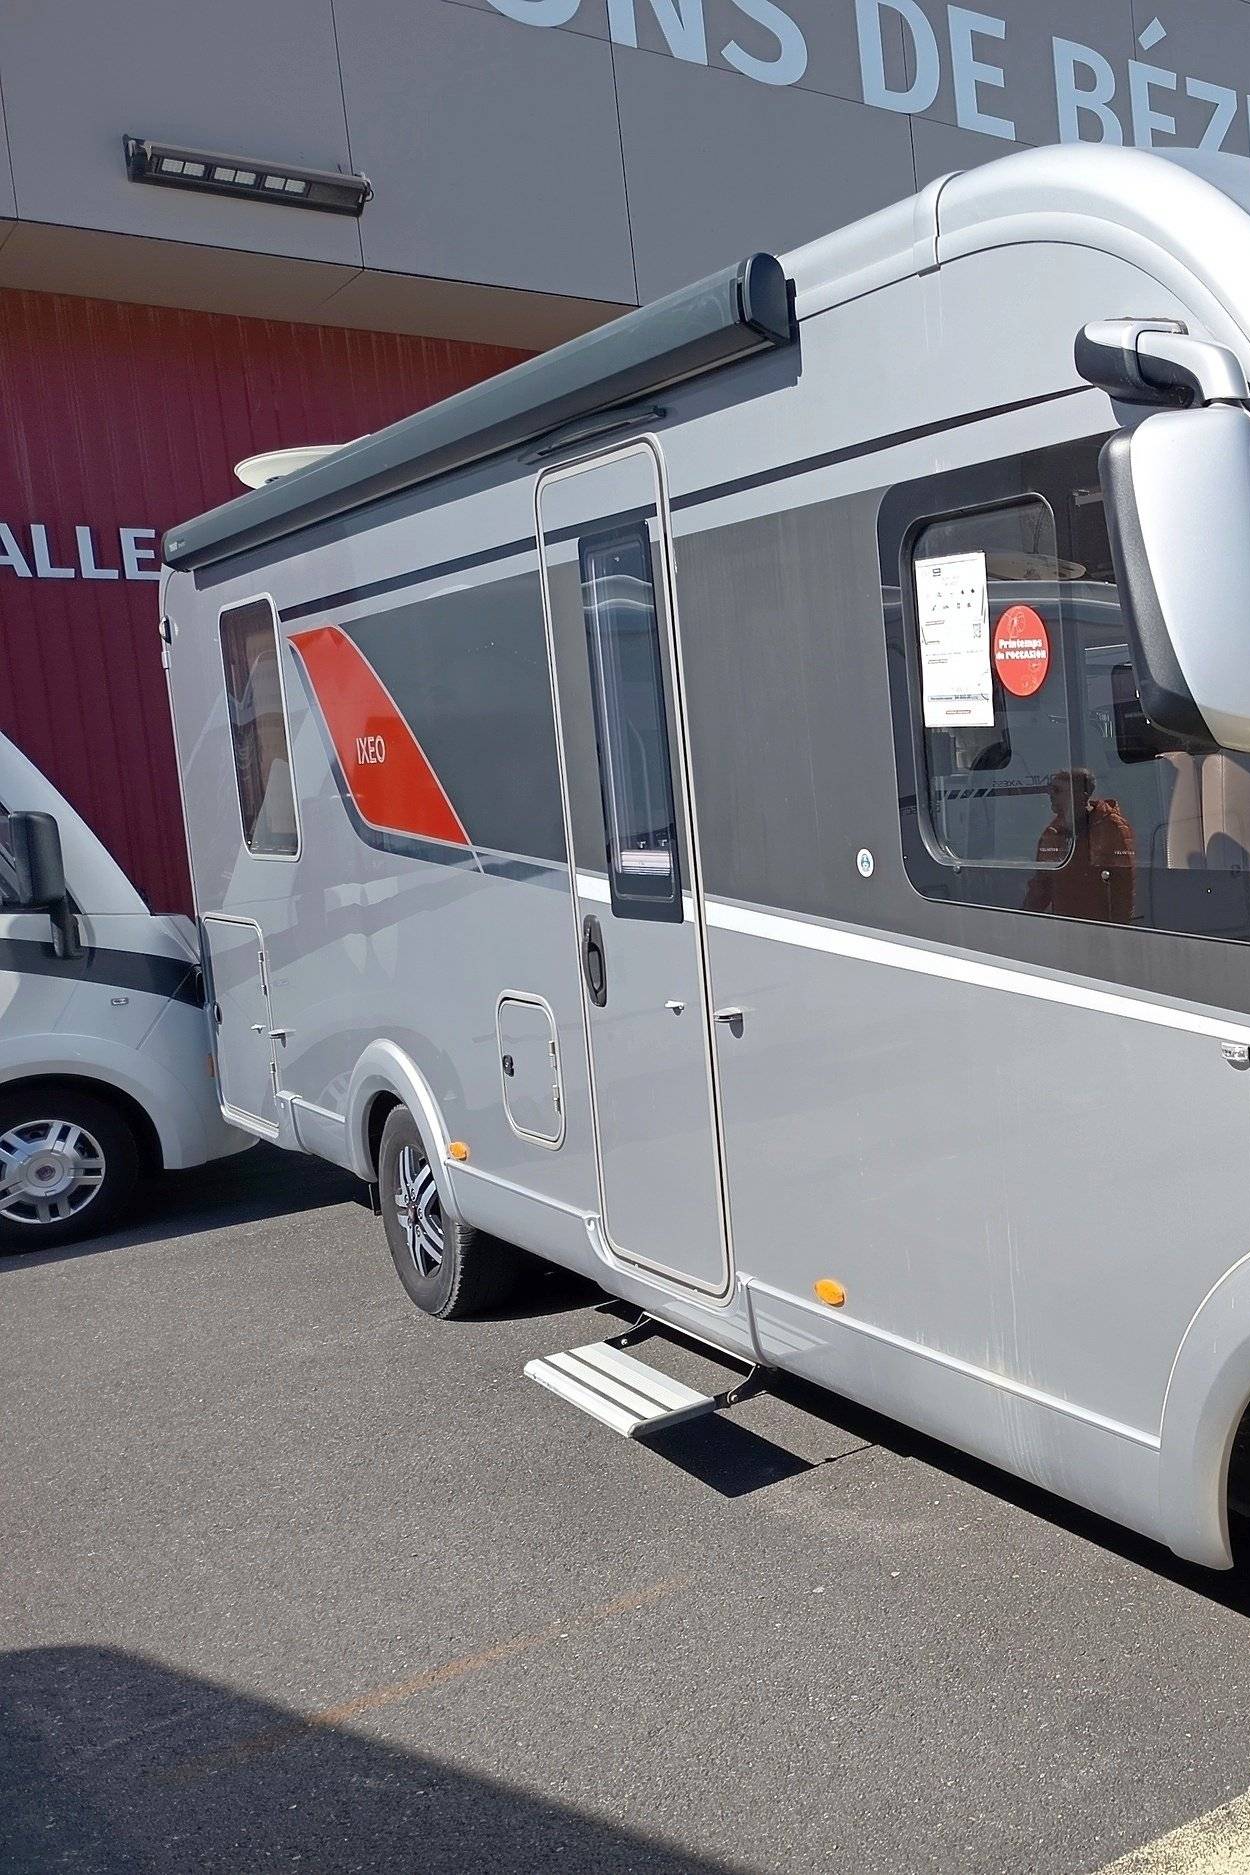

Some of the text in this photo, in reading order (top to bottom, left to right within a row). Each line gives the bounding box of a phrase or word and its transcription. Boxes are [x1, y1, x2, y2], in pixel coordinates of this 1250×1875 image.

[854, 0, 1016, 140] DE
[998, 637, 1043, 650] Printemps
[356, 735, 386, 765] IXEO
